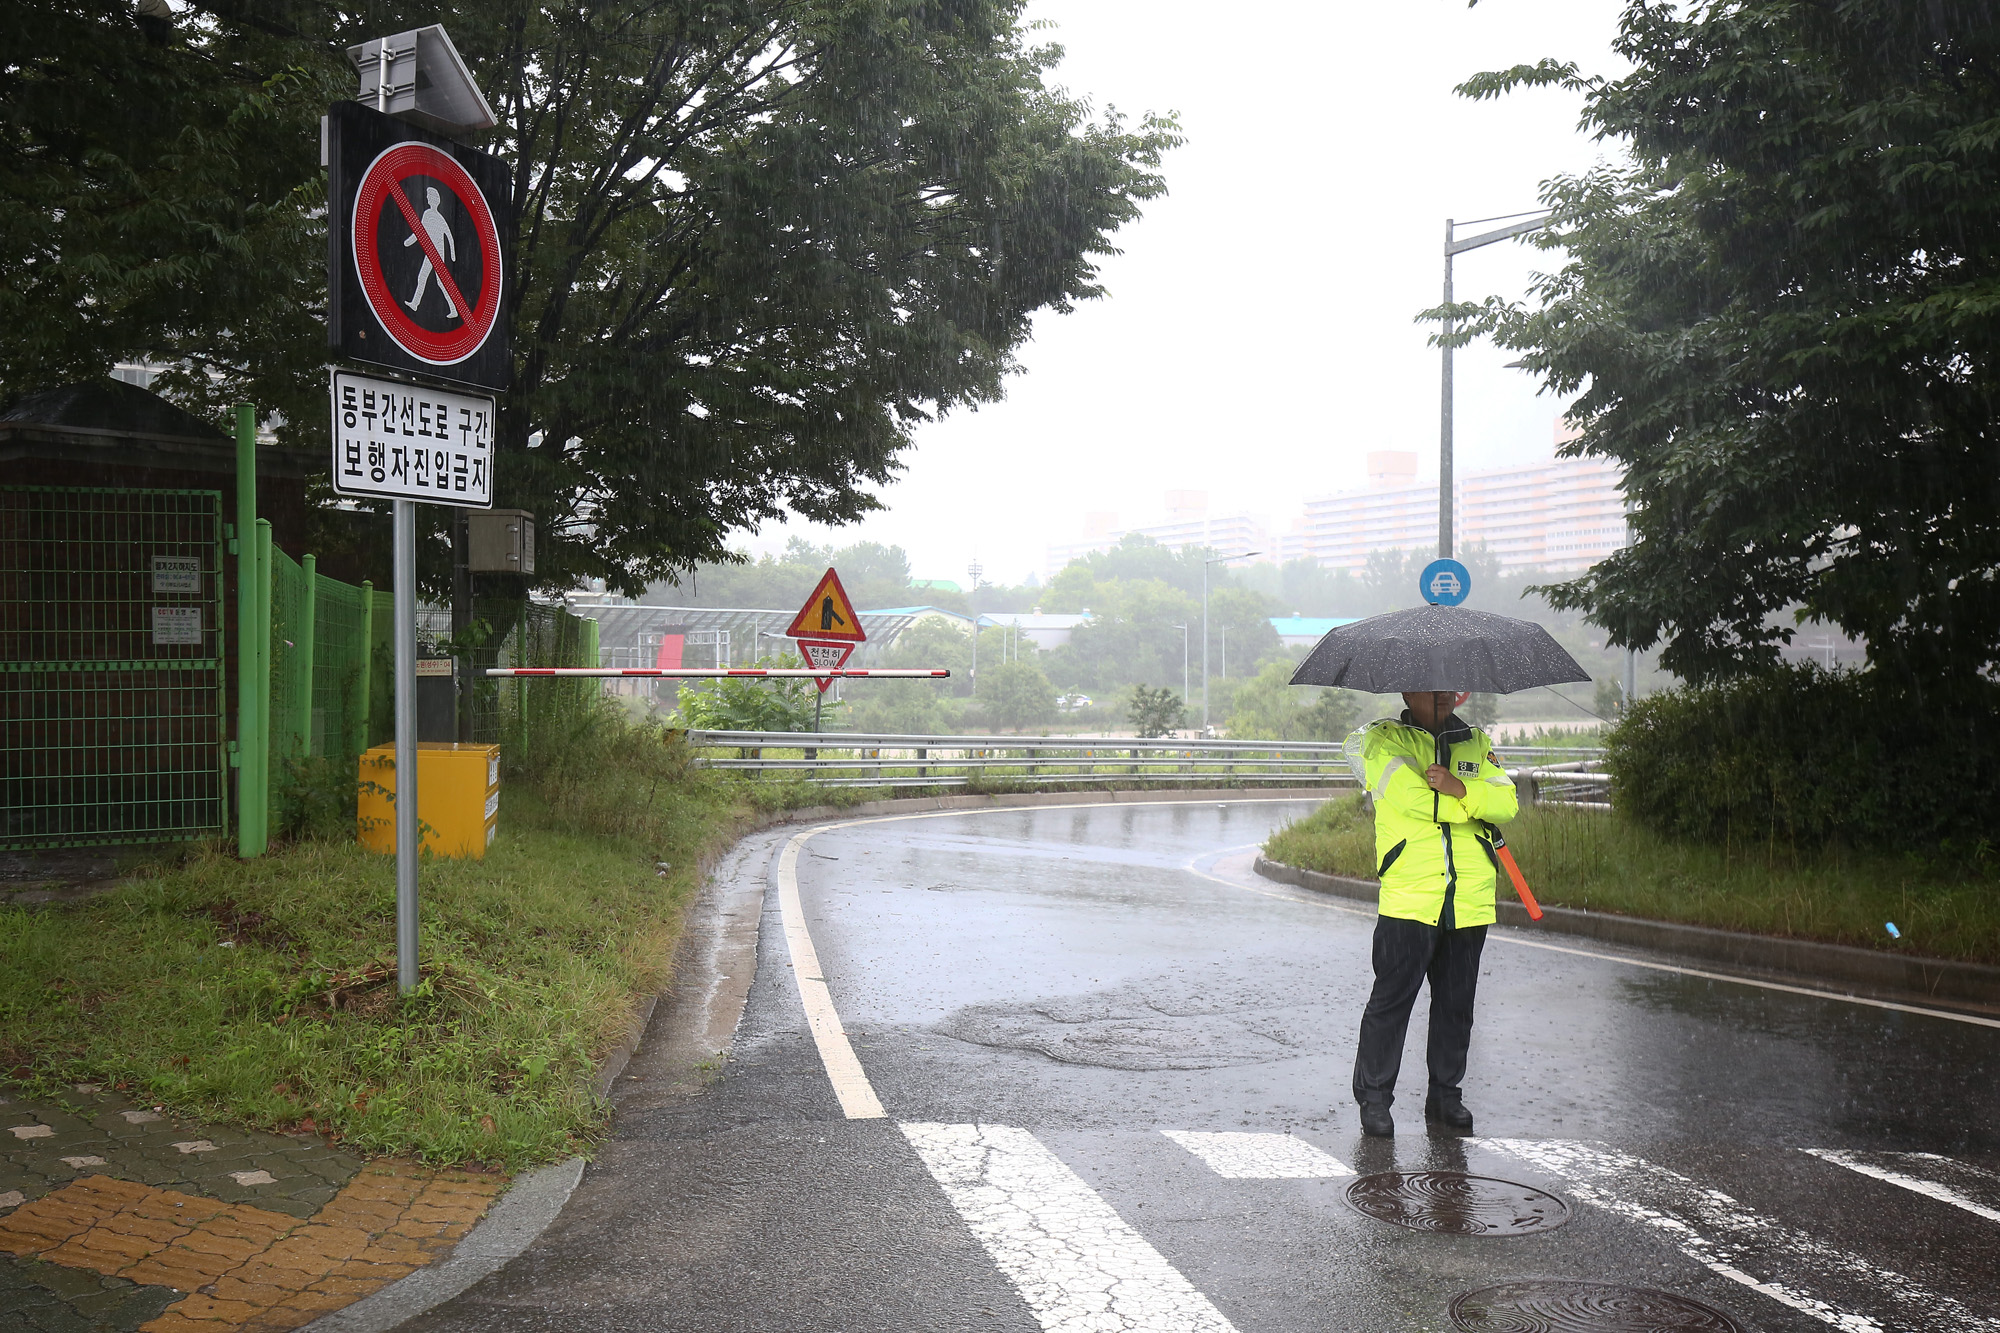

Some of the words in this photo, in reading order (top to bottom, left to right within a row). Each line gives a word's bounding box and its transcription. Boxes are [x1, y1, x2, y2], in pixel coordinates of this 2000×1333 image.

[342, 385, 449, 441] 동부간선도로
[458, 407, 488, 449] 구간
[344, 438, 487, 495] 보행자진입금지
[811, 648, 840, 659] 천천히
[814, 658, 836, 667] SLOW
